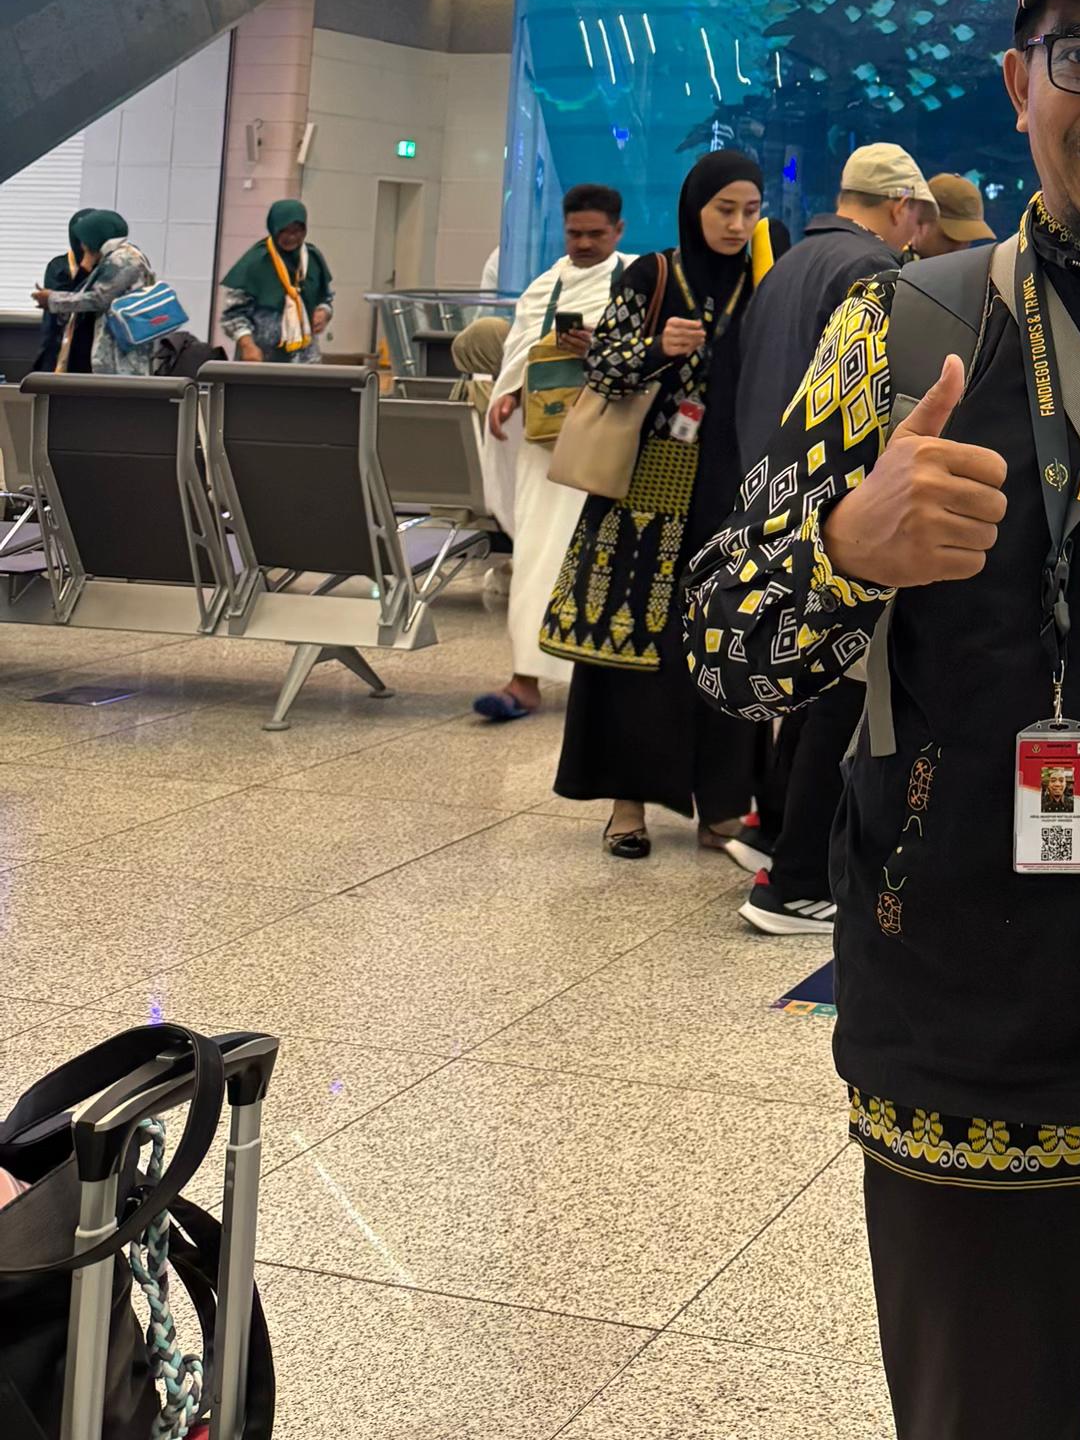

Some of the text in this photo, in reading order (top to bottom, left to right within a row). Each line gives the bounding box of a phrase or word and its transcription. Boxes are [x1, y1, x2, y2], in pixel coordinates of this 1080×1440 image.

[1023, 272, 1039, 314] TRAVEL
[1027, 314, 1042, 324] &
[1028, 321, 1048, 360] TOURS
[1034, 359, 1055, 417] FANDIEGO
